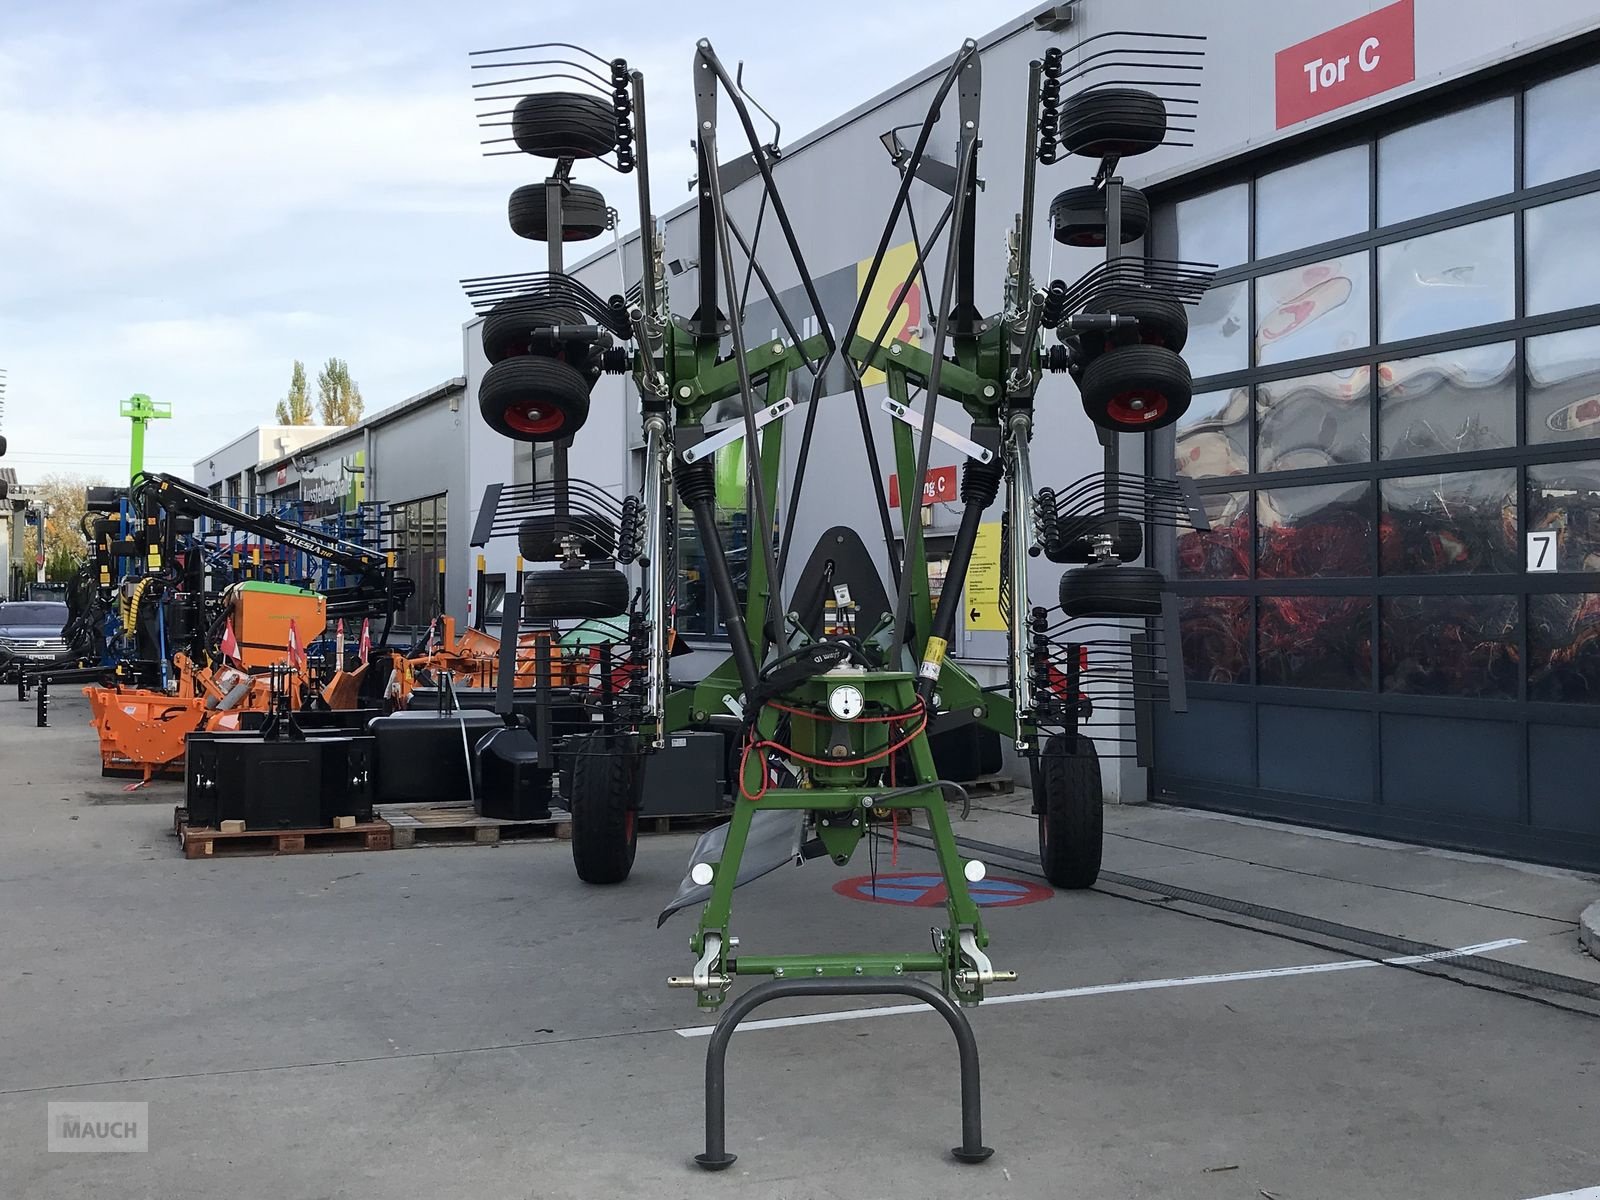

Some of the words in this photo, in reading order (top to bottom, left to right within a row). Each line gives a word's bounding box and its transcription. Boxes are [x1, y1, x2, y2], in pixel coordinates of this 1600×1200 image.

[1303, 55, 1350, 93] Tor
[1358, 36, 1381, 73] C
[938, 476, 945, 493] C
[290, 537, 321, 554] KESLA
[1533, 536, 1551, 568] 7
